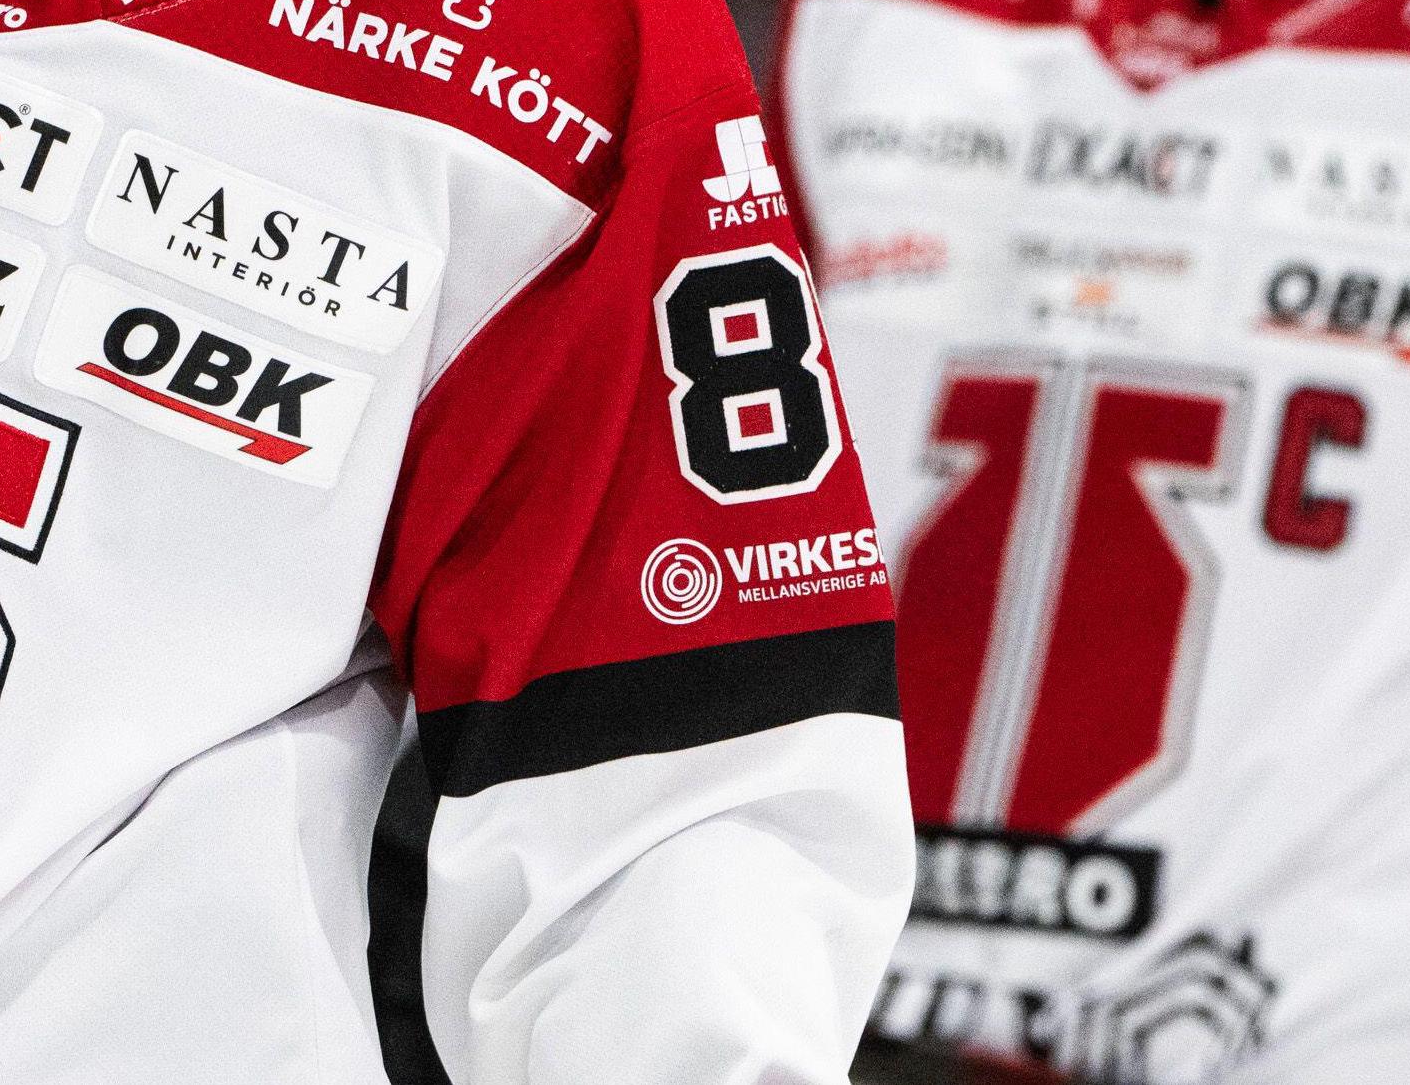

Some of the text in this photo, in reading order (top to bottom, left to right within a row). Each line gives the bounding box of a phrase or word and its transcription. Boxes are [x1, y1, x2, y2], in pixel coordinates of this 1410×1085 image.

[470, 56, 613, 164] KÖTT
[116, 152, 411, 312] NASTA
[166, 233, 341, 317] INTERIÖR
[103, 306, 336, 438] OBK
[653, 242, 843, 506] 8
[1260, 382, 1371, 555] C
[738, 573, 866, 604] MELLANSVERIGE
